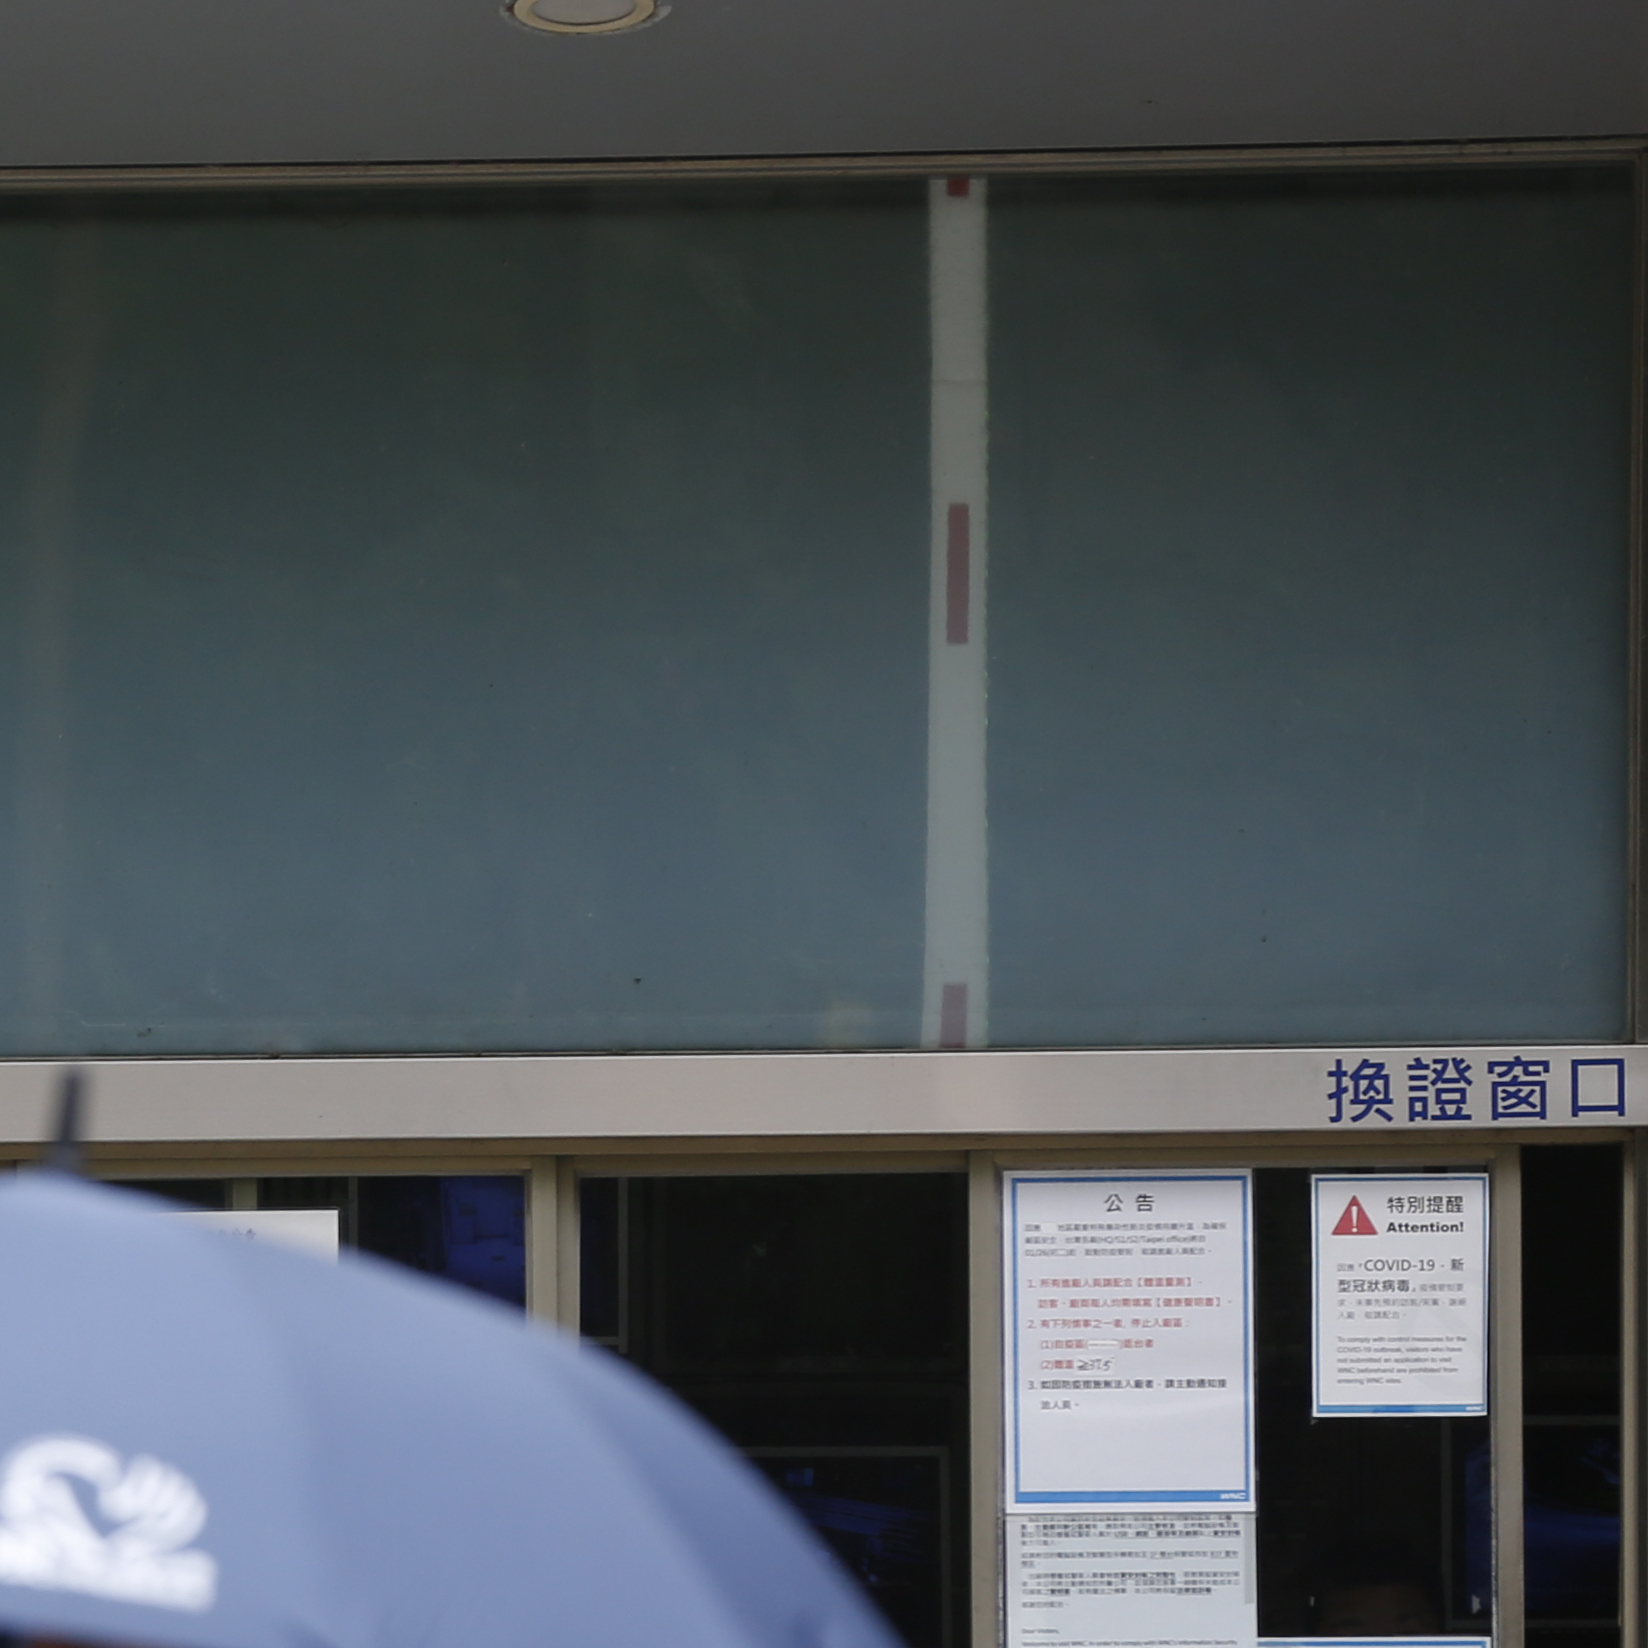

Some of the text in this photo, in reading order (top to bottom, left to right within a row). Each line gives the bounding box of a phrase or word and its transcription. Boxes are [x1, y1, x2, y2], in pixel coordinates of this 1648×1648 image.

[1327, 1056, 1626, 1123] 換證窗口
[1104, 1193, 1155, 1213] 公告
[1387, 1195, 1465, 1214] 特別提醒
[1386, 1222, 1465, 1233] Attention!
